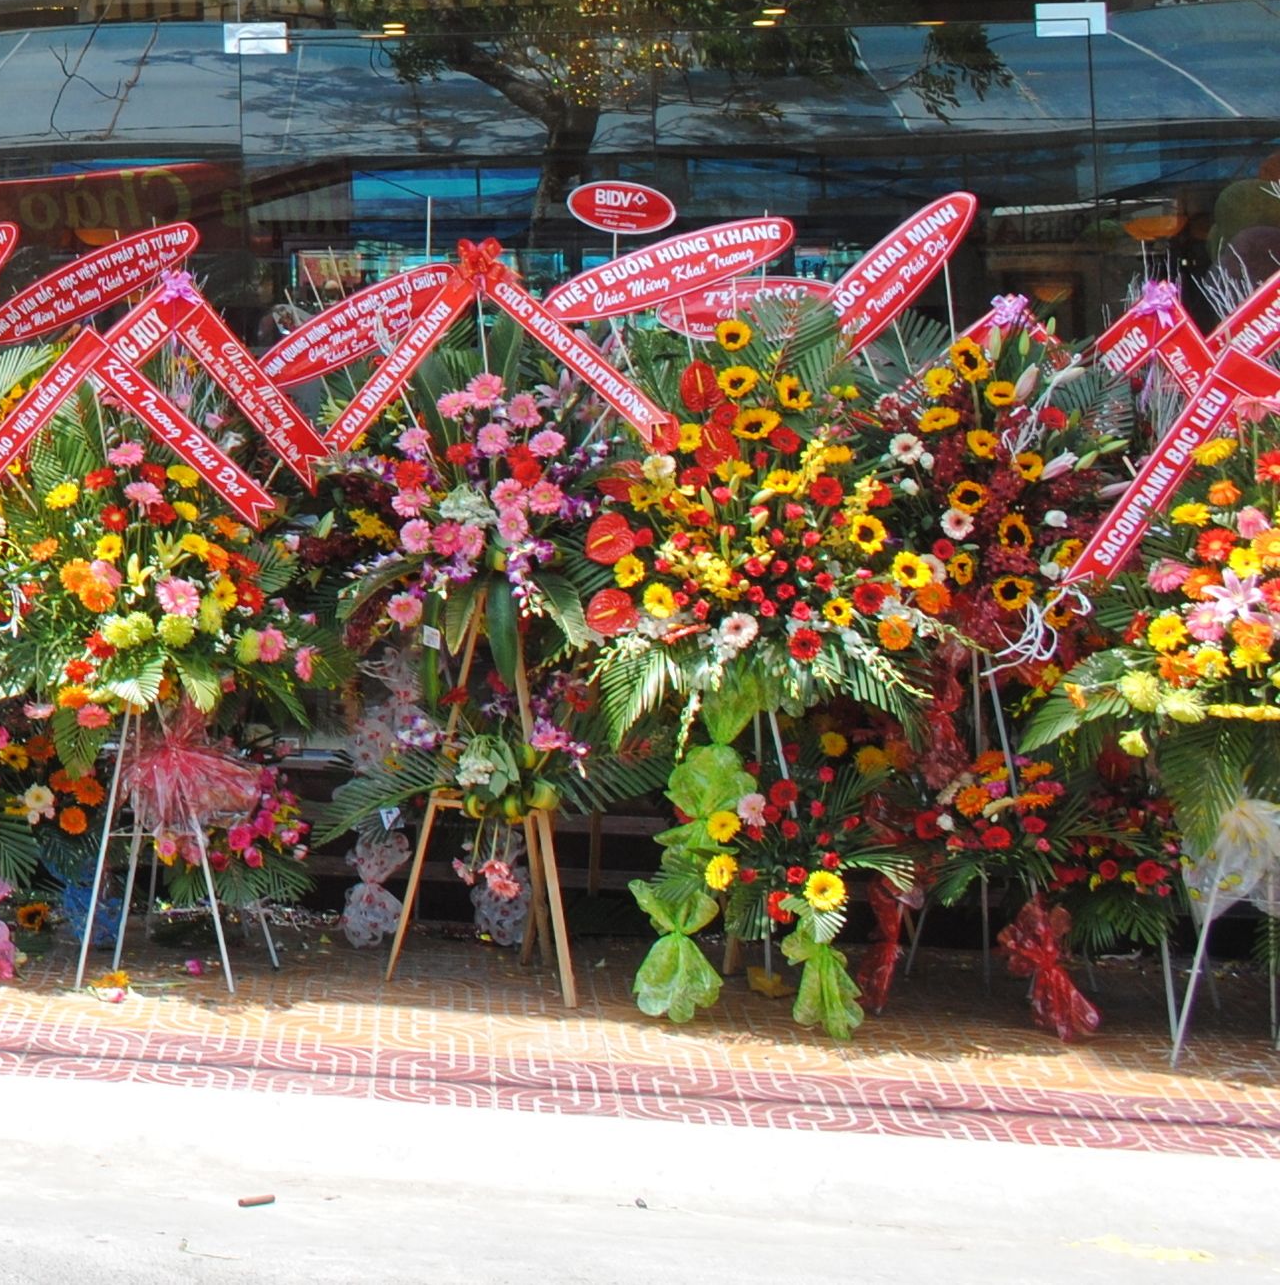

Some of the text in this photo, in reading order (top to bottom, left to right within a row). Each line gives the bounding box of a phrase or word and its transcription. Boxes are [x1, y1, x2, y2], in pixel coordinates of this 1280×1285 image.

[595, 188, 631, 206] BIDV
[17, 294, 37, 315] VĂN
[59, 274, 78, 291] HỌC
[77, 262, 99, 281] VIỆN
[110, 243, 135, 264] PHÁP
[162, 224, 191, 247] PHÁP
[556, 224, 781, 311] HIỆU BUÔN HƯNG KHANG
[862, 243, 908, 283] KHAI
[907, 204, 957, 246] MINH
[900, 257, 927, 282] Phát
[924, 236, 948, 259] Đạt
[492, 280, 573, 352] CHÚC MỪNG
[595, 250, 753, 312] Chúc Mừng Khai Trương
[128, 307, 170, 350] HUY
[282, 336, 310, 361] QUANG
[12, 406, 40, 435] VIỆN
[55, 360, 77, 386] SÁT
[219, 339, 297, 429] Chúc Mừng
[358, 374, 393, 410] ĐÌNH
[102, 356, 247, 500] Khai Trương Phát Đạt
[1096, 389, 1227, 563] SACOMBANK LIÊU
